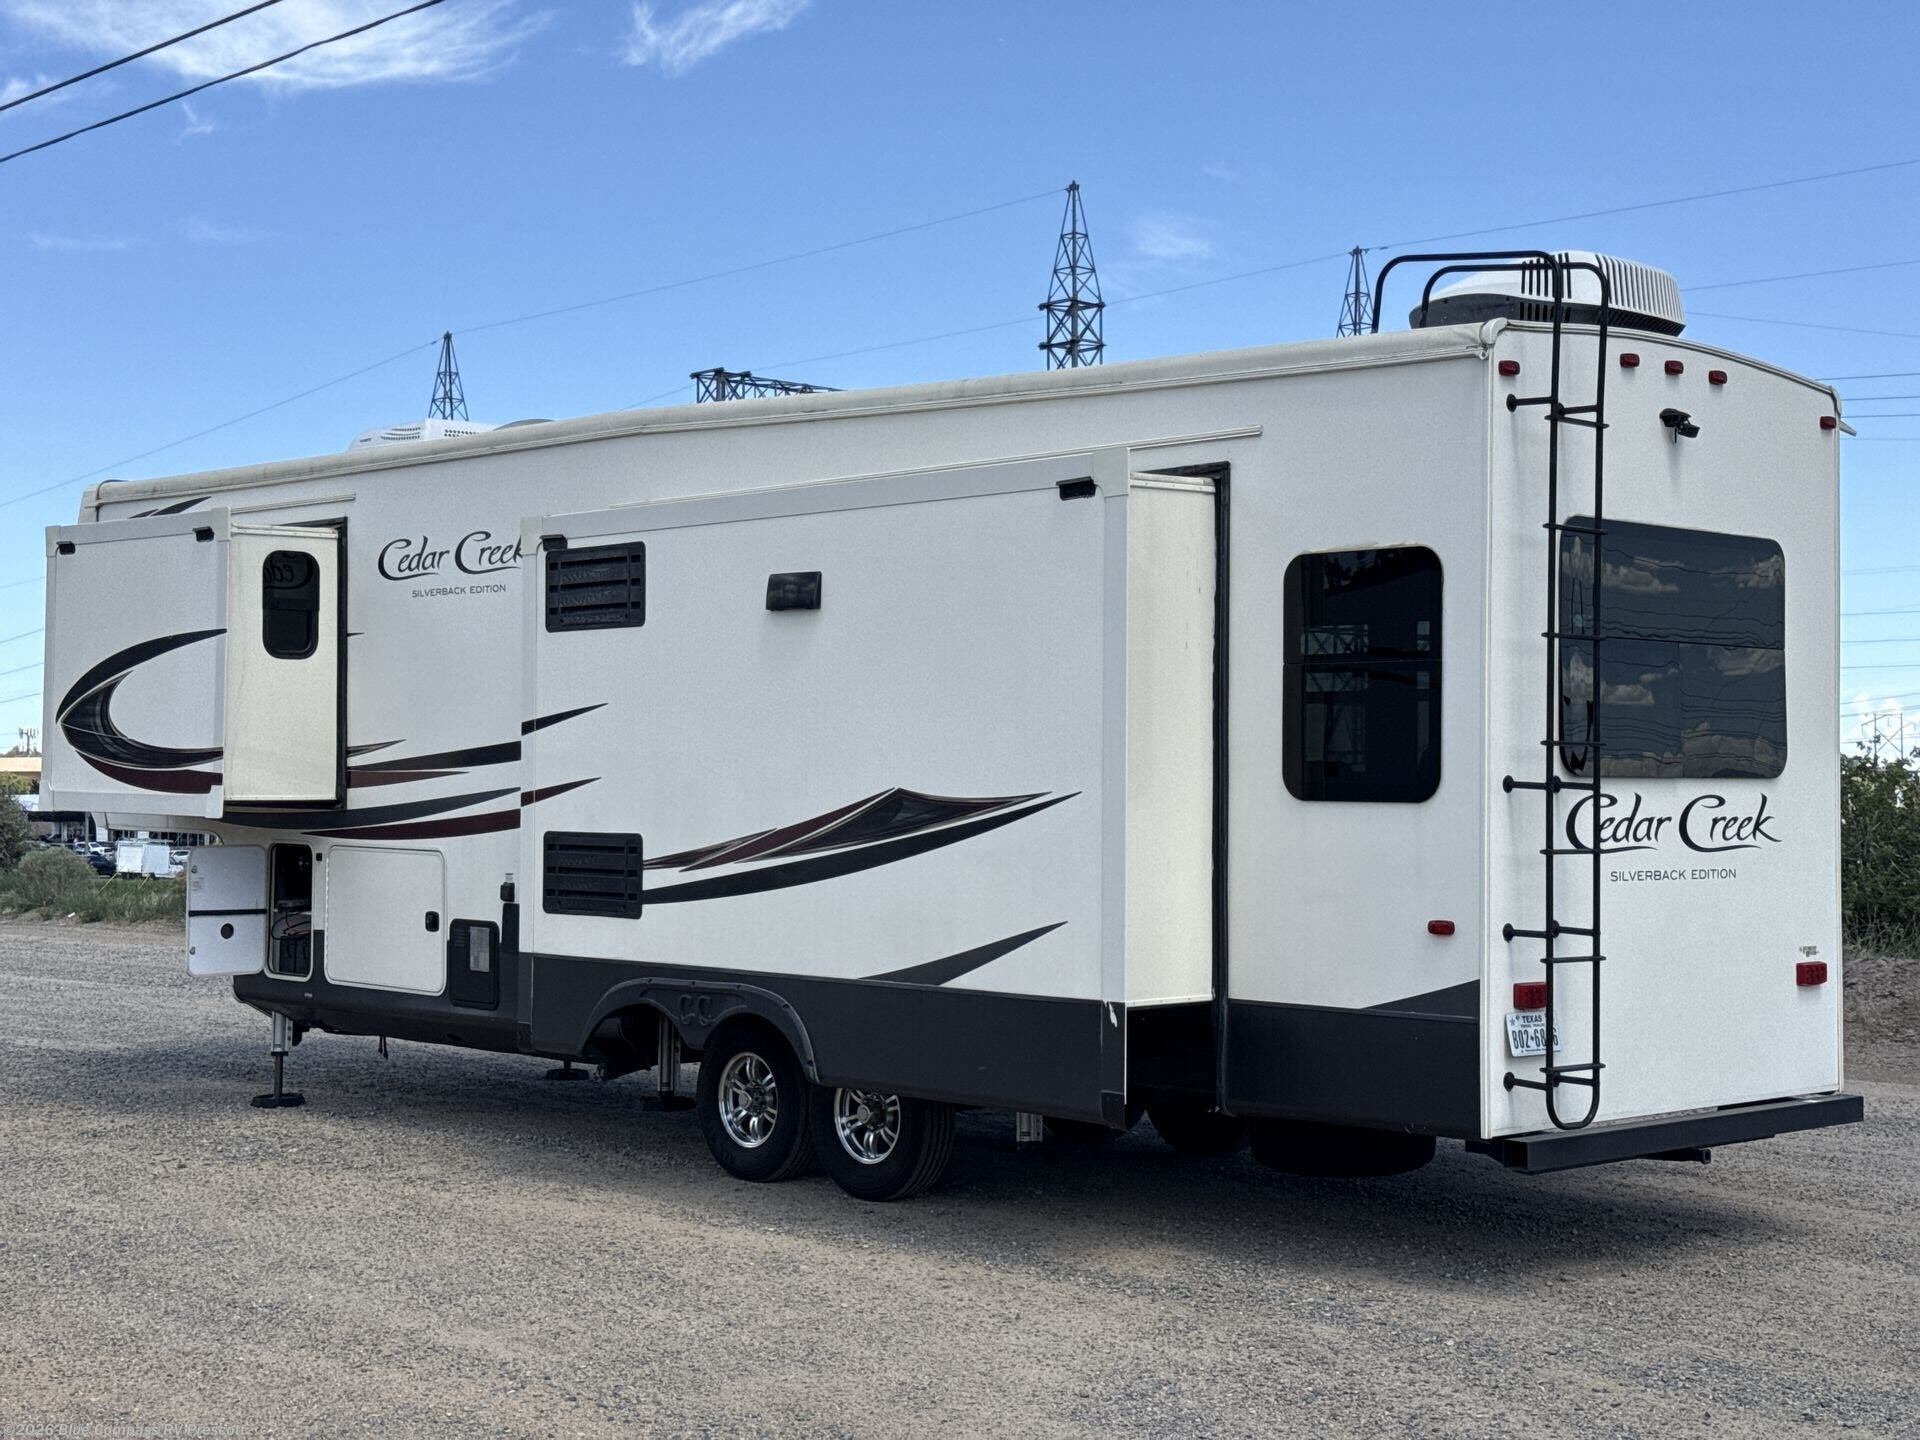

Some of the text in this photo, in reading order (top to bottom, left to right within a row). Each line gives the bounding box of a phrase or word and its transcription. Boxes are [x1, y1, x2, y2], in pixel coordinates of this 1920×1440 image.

[378, 530, 523, 581] Cedar Creek
[412, 584, 506, 598] SILVERBACK EDITION
[1566, 792, 1784, 854] Cedar Creek
[1610, 868, 1737, 882] SILVERBACK EDITION
[1521, 1015, 1543, 1023] TEXAS
